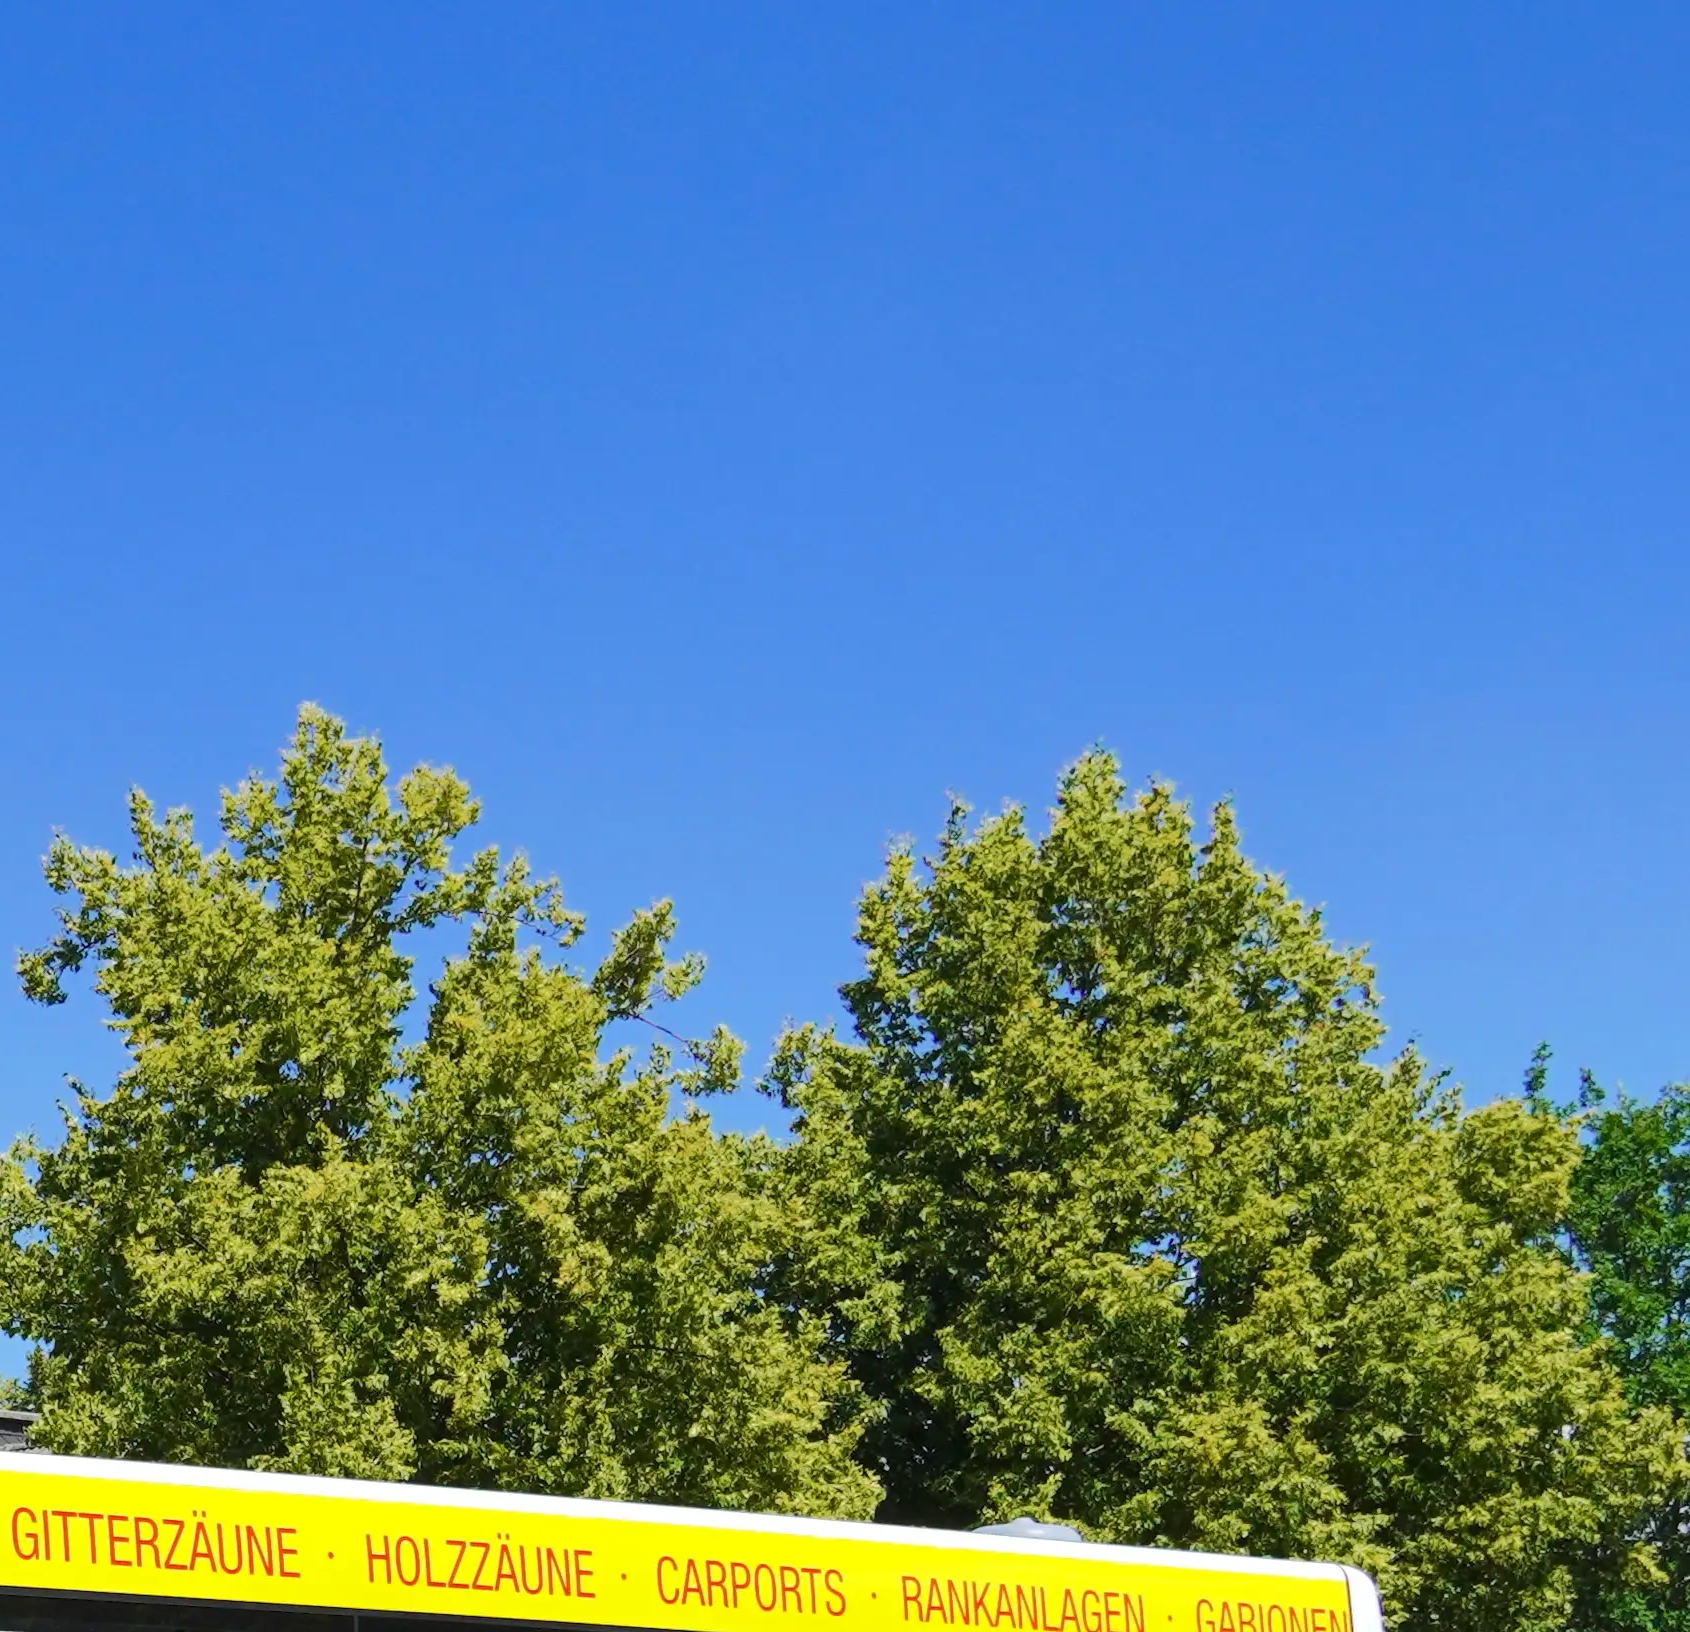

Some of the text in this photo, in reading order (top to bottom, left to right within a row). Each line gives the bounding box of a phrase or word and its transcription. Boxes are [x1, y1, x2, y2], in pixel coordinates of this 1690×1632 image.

[11, 1506, 301, 1579] GITTERZÄUNE
[365, 1533, 596, 1599] HOLZZÄUNE
[656, 1555, 846, 1617] CARPORTS
